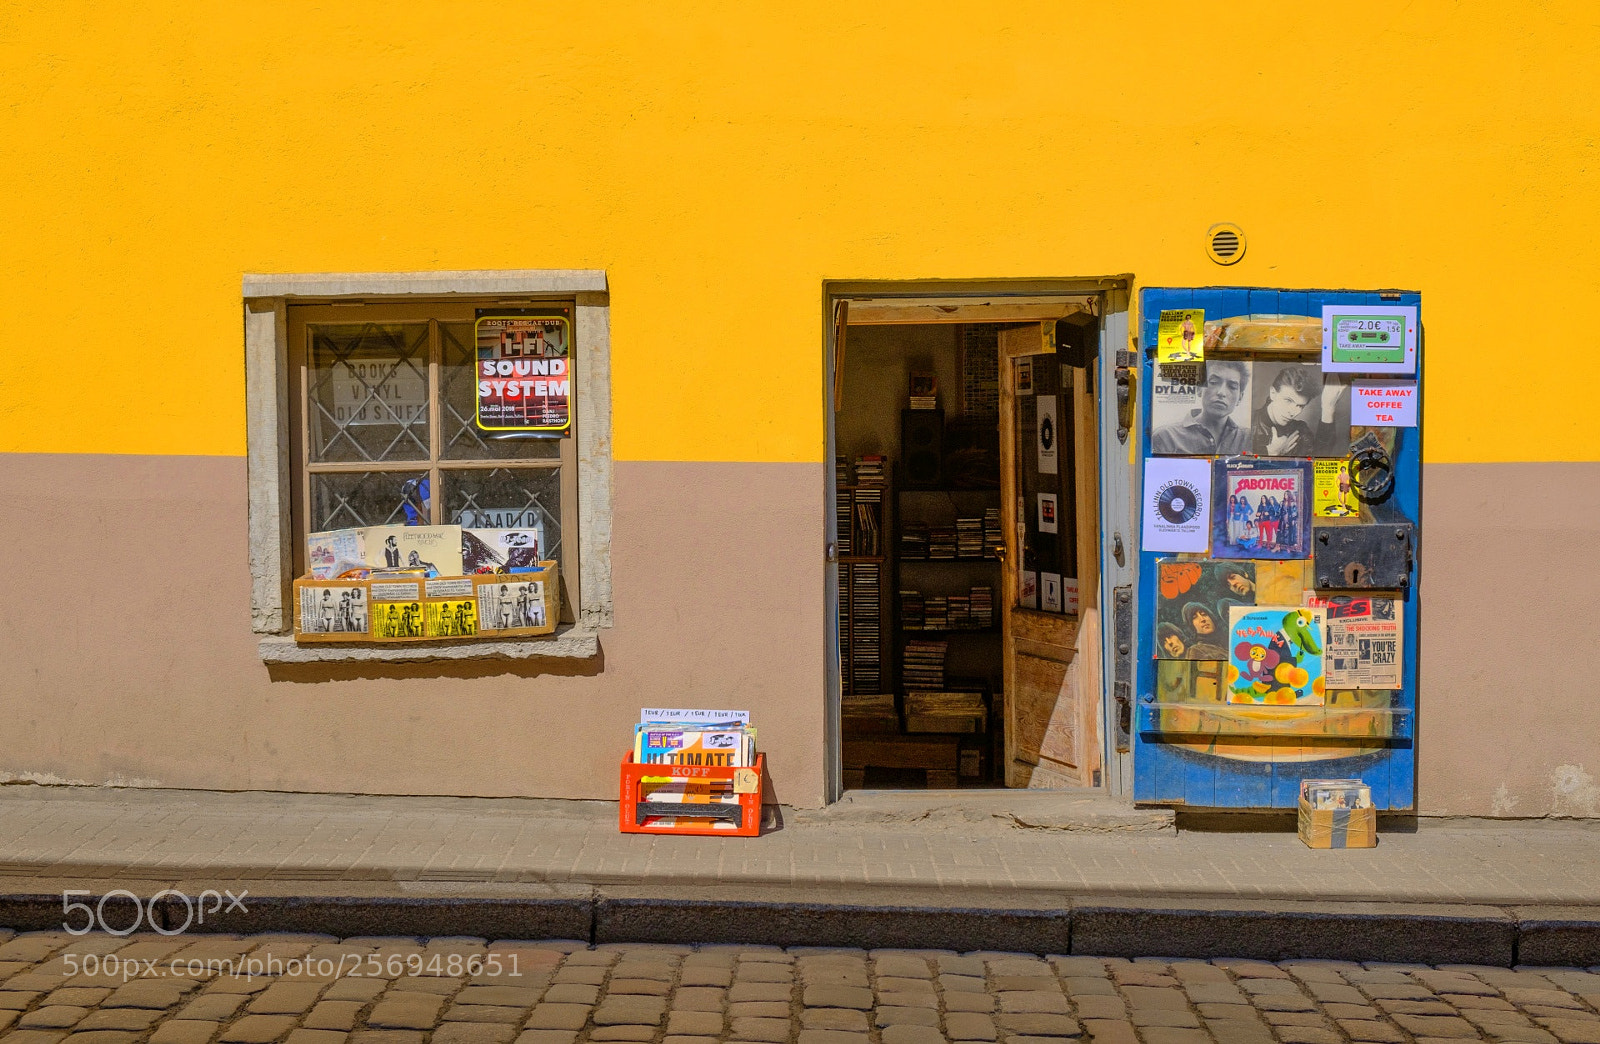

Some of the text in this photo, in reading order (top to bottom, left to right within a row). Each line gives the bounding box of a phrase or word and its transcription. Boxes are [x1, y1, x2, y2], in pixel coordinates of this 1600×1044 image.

[1358, 320, 1381, 331] 2.0€
[483, 359, 566, 376] SOUND
[1171, 377, 1197, 386] BOB
[479, 380, 569, 397] SYSTEM
[1155, 385, 1197, 395] DYLAN
[1358, 389, 1413, 397] TAKE AWAY
[1367, 401, 1403, 409] COFFEE
[1375, 414, 1394, 422] TEA
[1234, 478, 1295, 495] SABOTAGE
[1160, 480, 1174, 492] OLD
[1174, 479, 1195, 490] TOWN
[1193, 487, 1204, 522] RECORDS
[1236, 626, 1285, 648] ЧЕБУРАШКА
[1371, 641, 1397, 653] YOU'RE
[1372, 652, 1397, 664] CRAZY
[671, 766, 711, 777] KOFF
